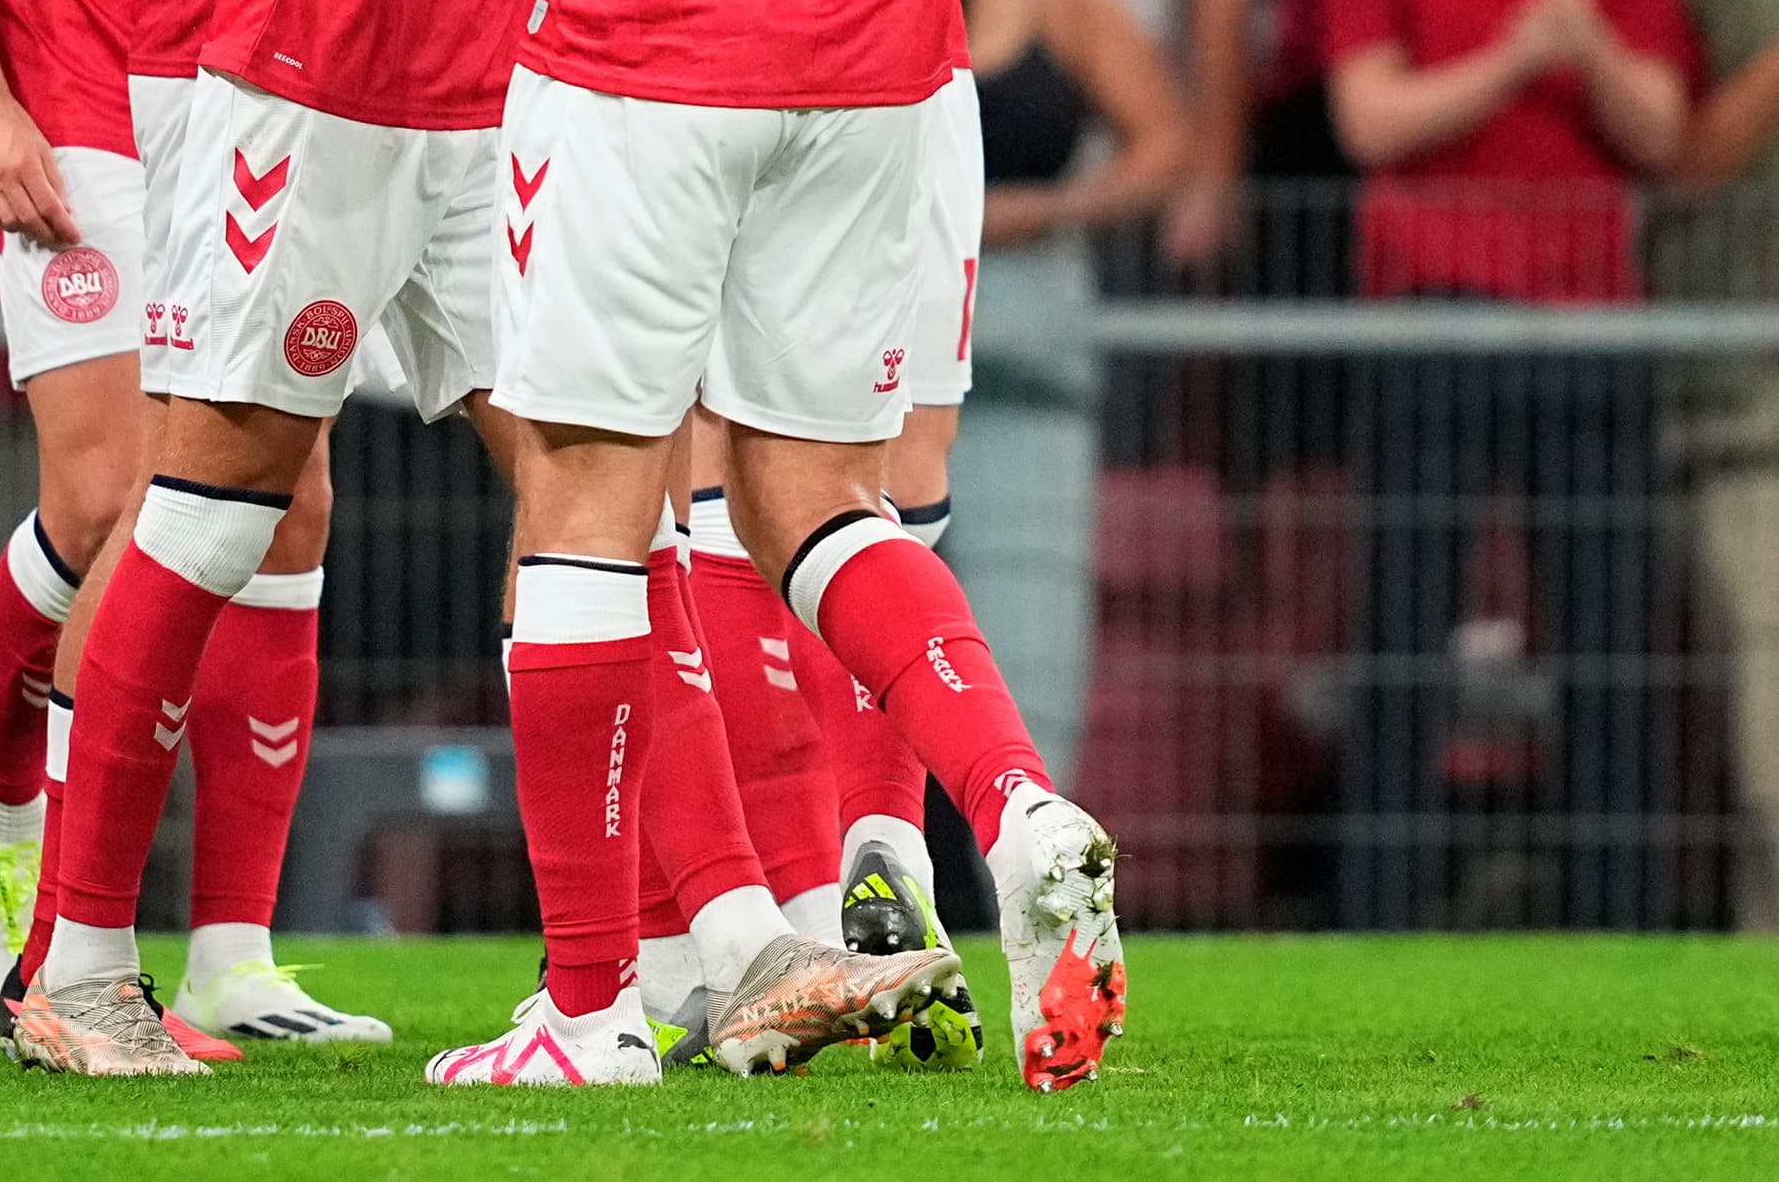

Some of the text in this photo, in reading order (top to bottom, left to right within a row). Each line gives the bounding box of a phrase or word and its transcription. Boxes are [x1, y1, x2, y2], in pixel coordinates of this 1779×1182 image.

[58, 271, 103, 298] DBU
[301, 327, 342, 350] DBU
[605, 704, 631, 838] DANMARK
